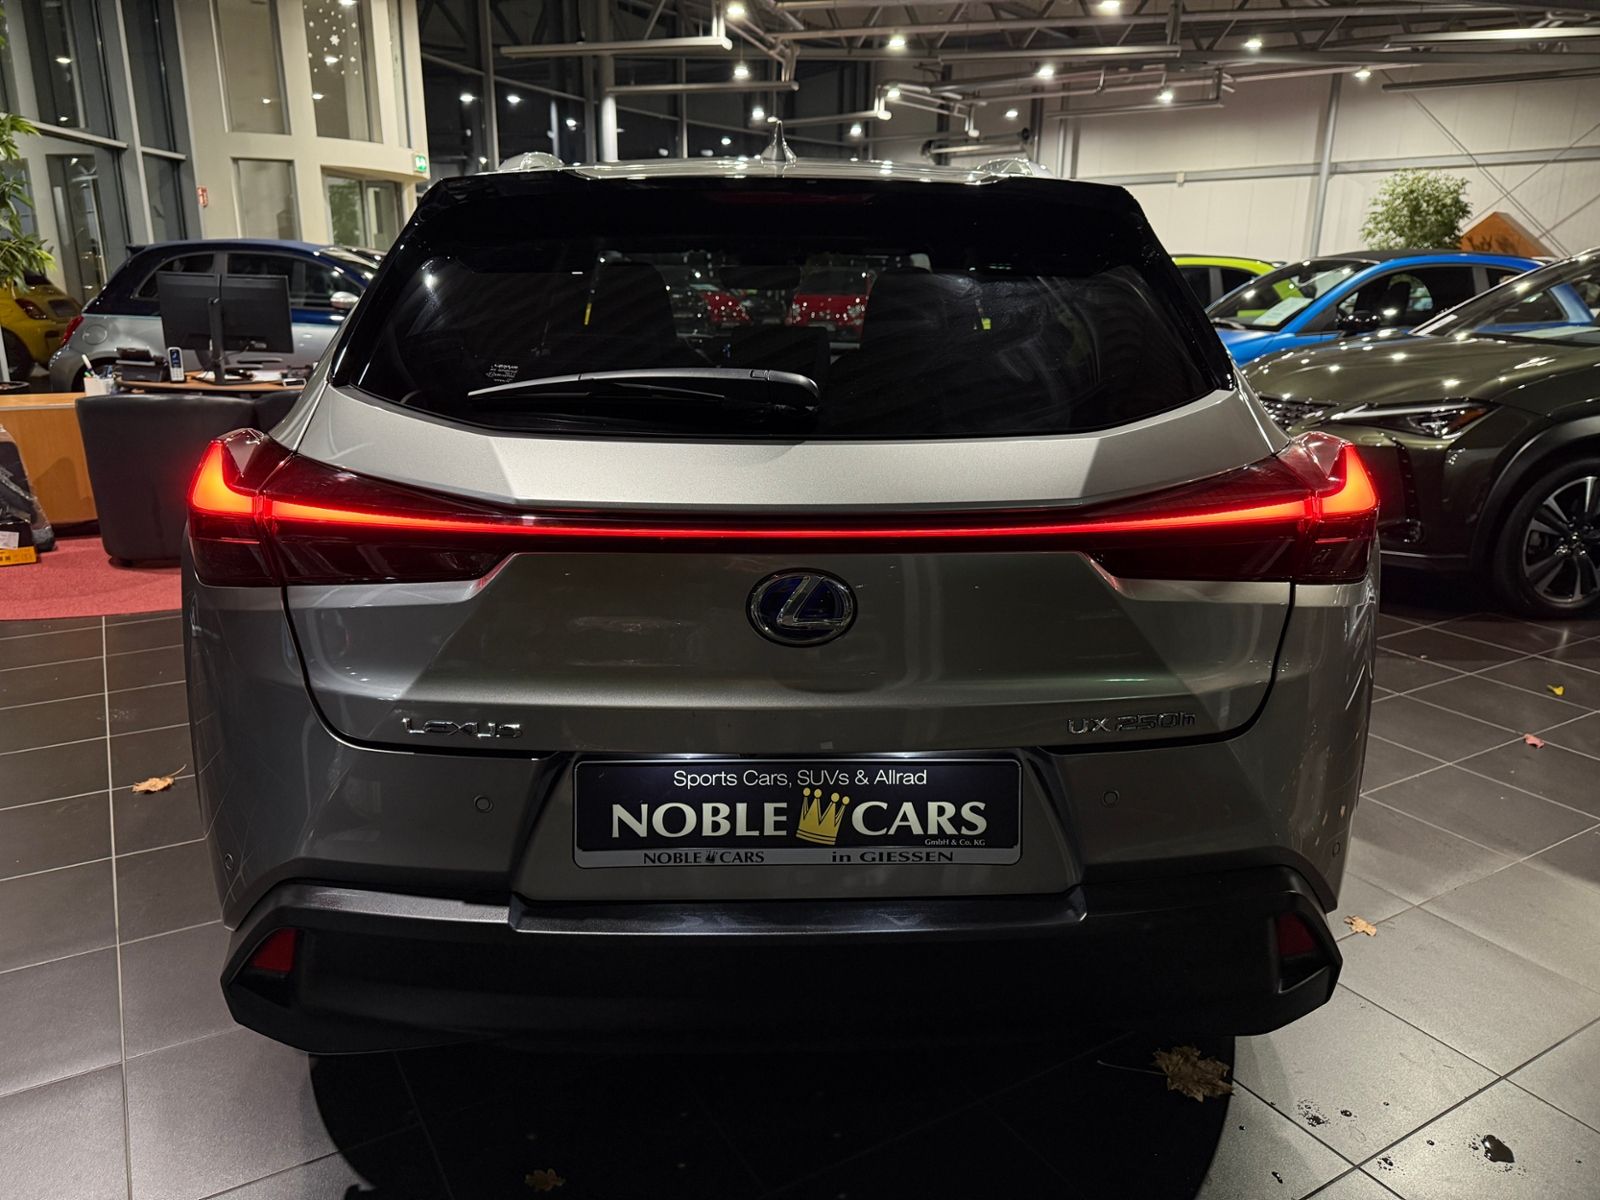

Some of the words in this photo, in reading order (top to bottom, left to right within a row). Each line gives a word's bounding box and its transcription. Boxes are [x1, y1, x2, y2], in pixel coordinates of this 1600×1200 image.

[402, 717, 524, 739] LEXUS
[1068, 717, 1111, 735] UX
[673, 770, 738, 790] Sports
[743, 769, 792, 789] Cars,
[797, 769, 850, 786] SUVs
[854, 769, 870, 786] &
[873, 768, 928, 786] Allrad
[612, 802, 788, 839] NOBLE
[851, 801, 988, 836] CARS
[924, 838, 949, 846] GmbH
[951, 838, 957, 846] &
[959, 838, 972, 846] Co.
[974, 838, 985, 846] KG
[642, 851, 703, 865] NOBLE
[719, 850, 766, 864] CARS
[831, 850, 852, 863] in
[858, 850, 954, 863] GIESSEN
